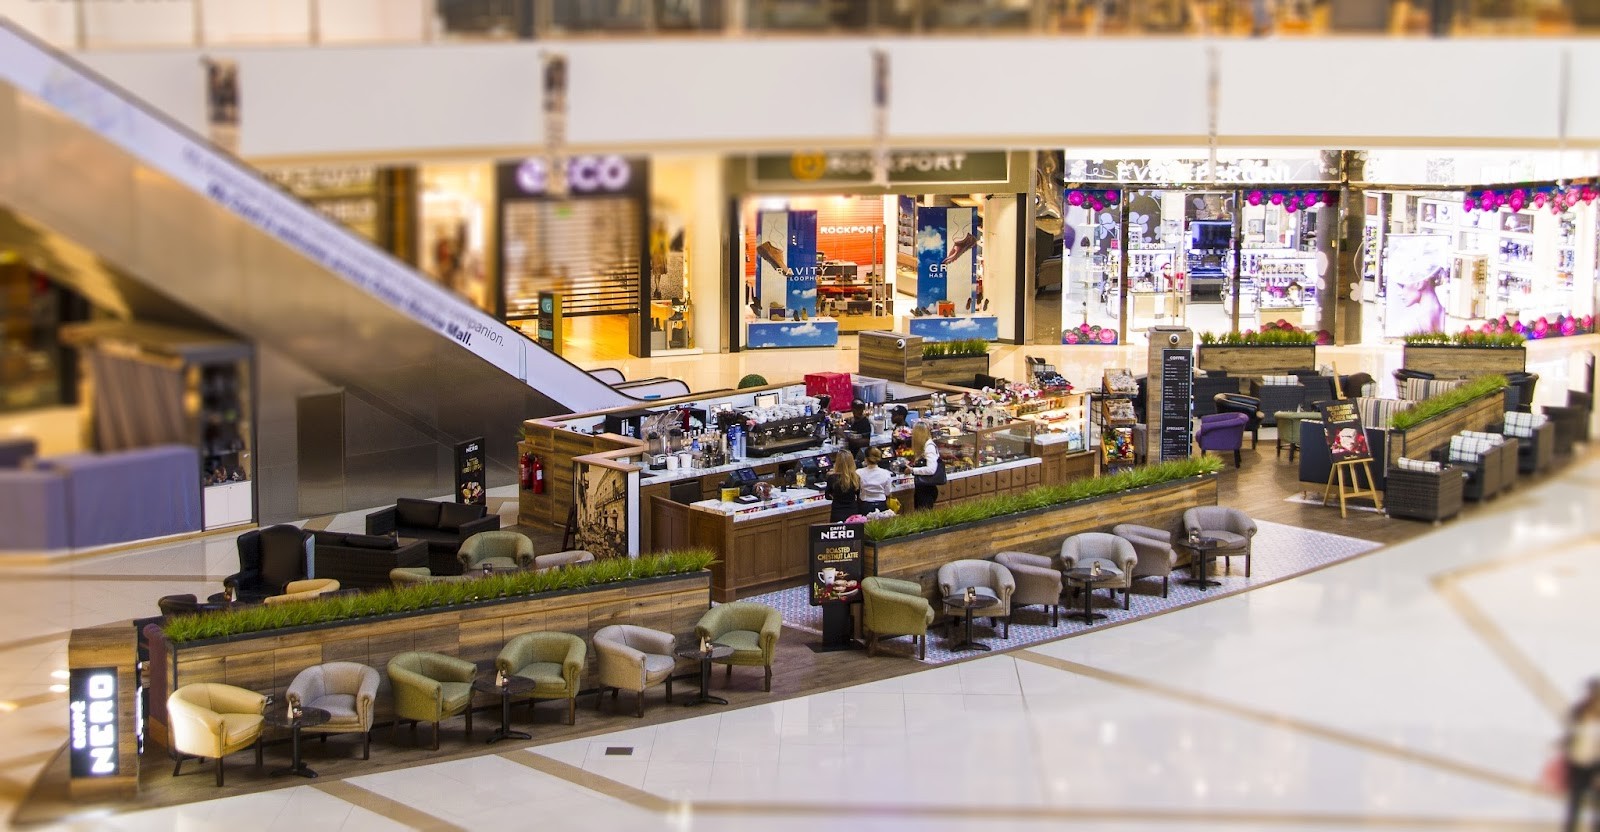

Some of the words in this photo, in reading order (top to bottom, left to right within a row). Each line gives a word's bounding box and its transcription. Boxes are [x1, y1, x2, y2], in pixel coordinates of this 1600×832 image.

[820, 225, 881, 234] ROCKPORT
[776, 266, 828, 276] RAVITY
[821, 530, 854, 540] NERO
[825, 546, 850, 554] ROASTED
[818, 553, 843, 561] CHESTNUT
[88, 674, 115, 774] NERO
